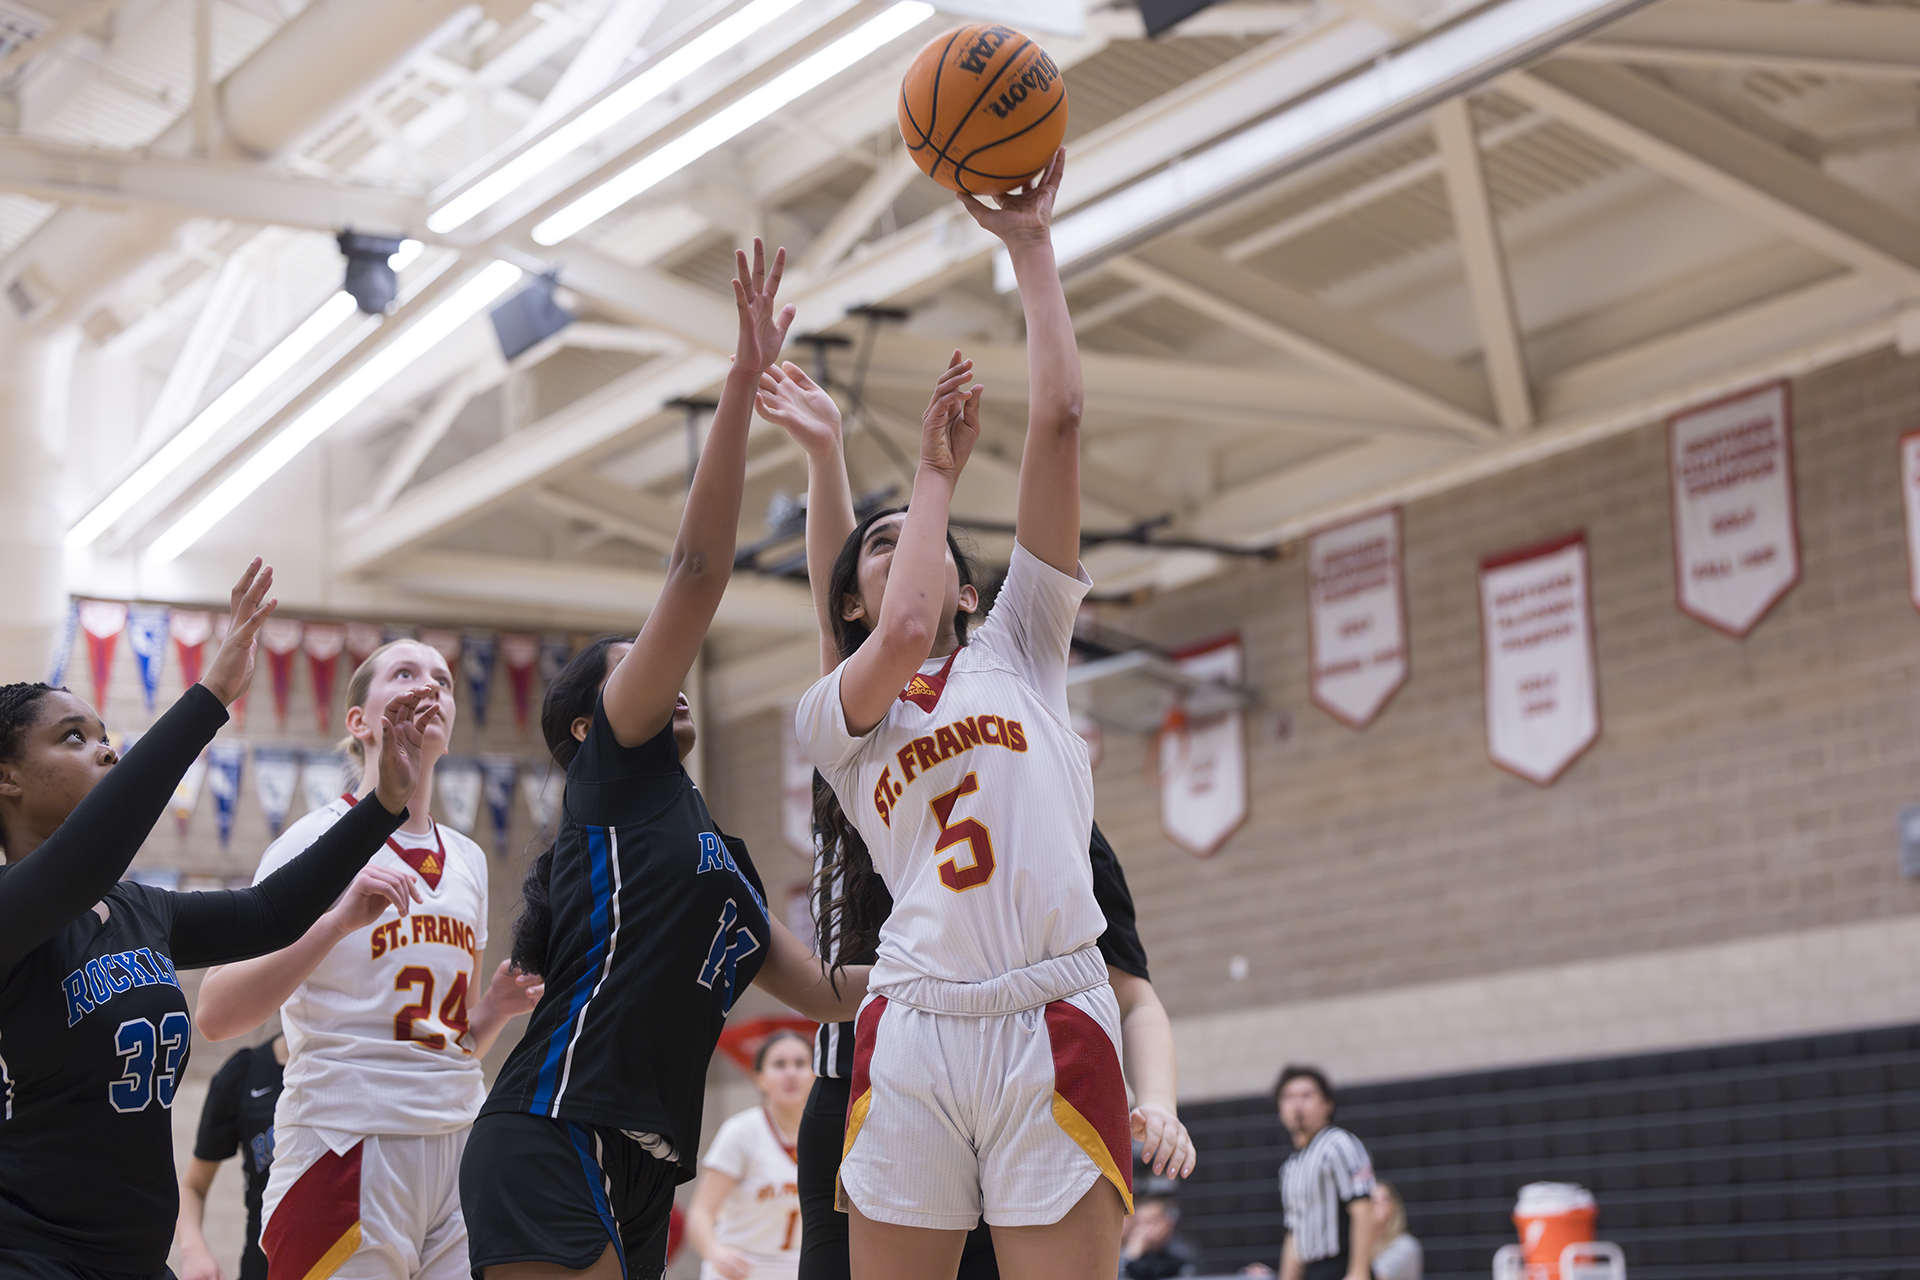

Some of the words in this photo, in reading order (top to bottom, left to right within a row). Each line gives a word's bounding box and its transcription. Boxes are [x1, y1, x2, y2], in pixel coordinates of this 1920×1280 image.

[906, 687, 937, 697] adidas
[873, 763, 904, 830] ST.
[896, 714, 1029, 786] FRANCIS
[928, 771, 997, 894] 5
[370, 918, 408, 961] ST.
[393, 964, 473, 1055] 24
[108, 1011, 191, 1114] 33
